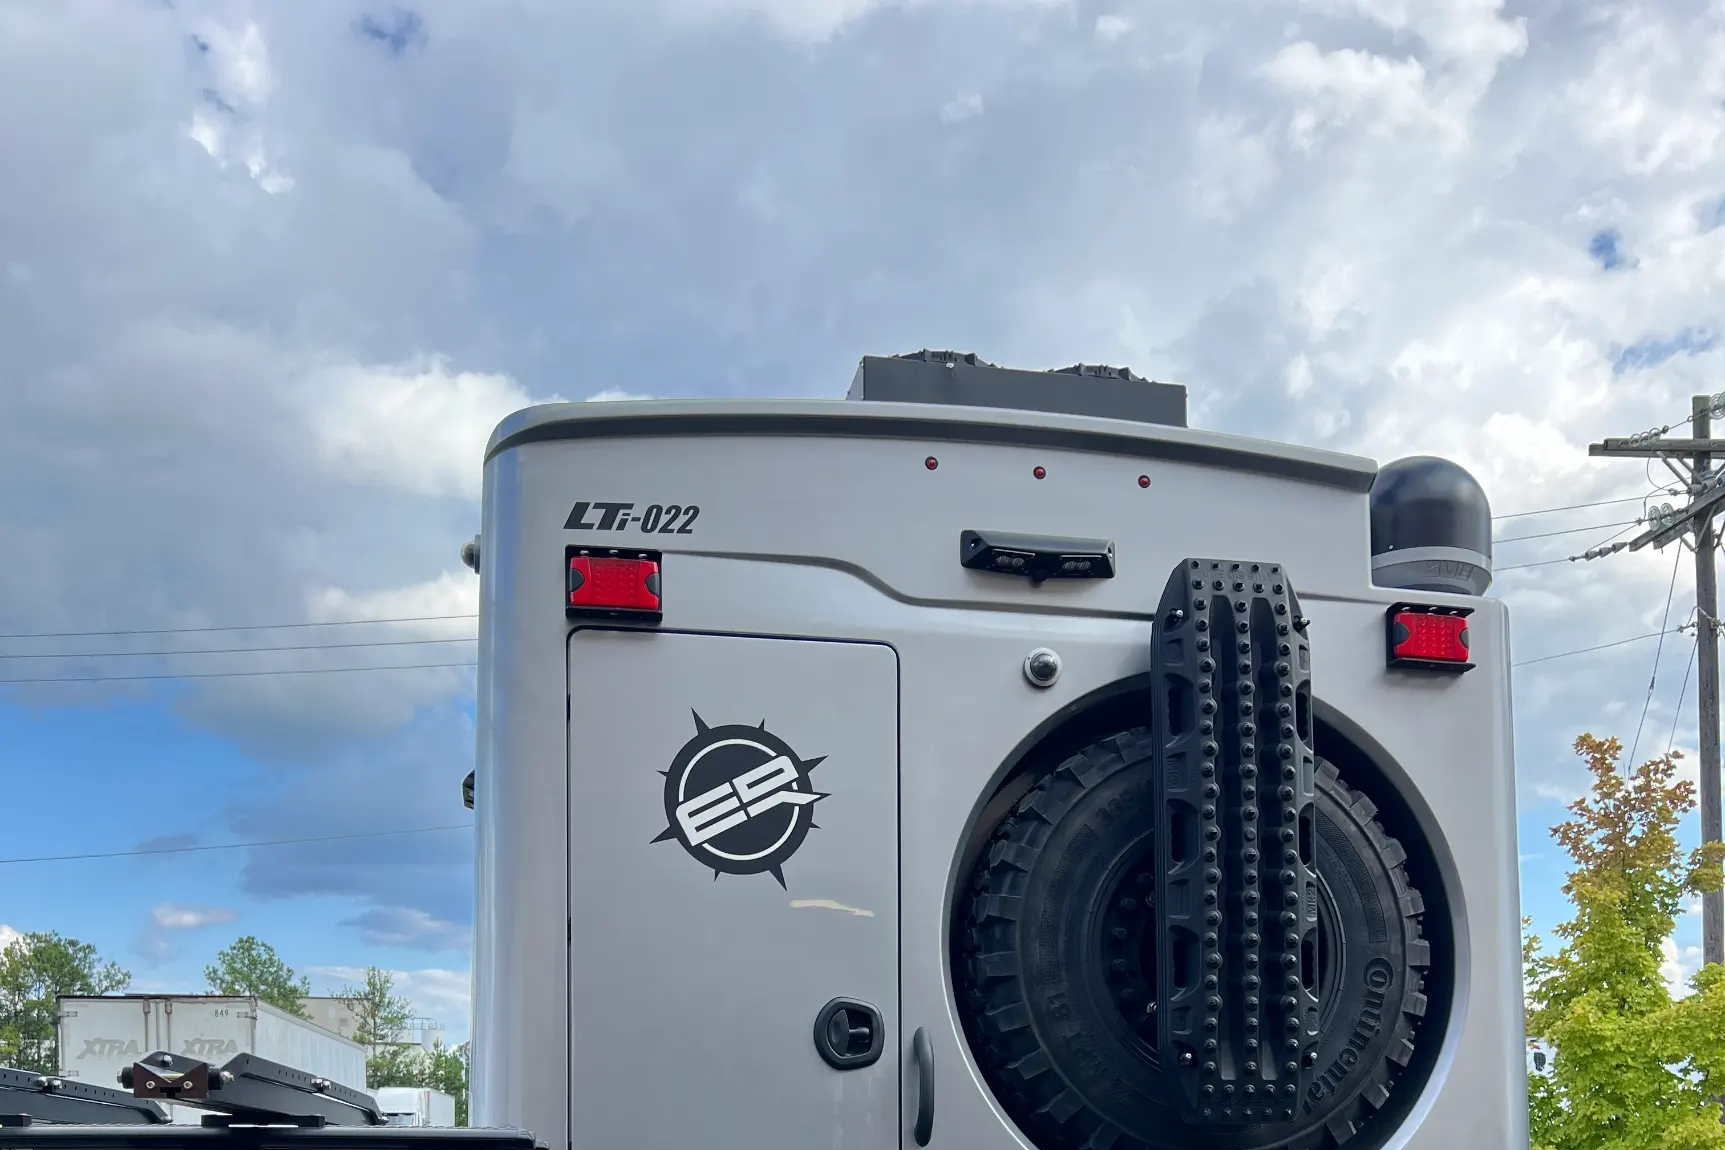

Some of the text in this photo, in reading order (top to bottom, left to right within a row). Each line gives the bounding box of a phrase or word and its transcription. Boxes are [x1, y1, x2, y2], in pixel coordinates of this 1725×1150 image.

[213, 1008, 230, 1018] 849
[76, 1037, 142, 1060] XTRA
[180, 1037, 239, 1055] XTRA
